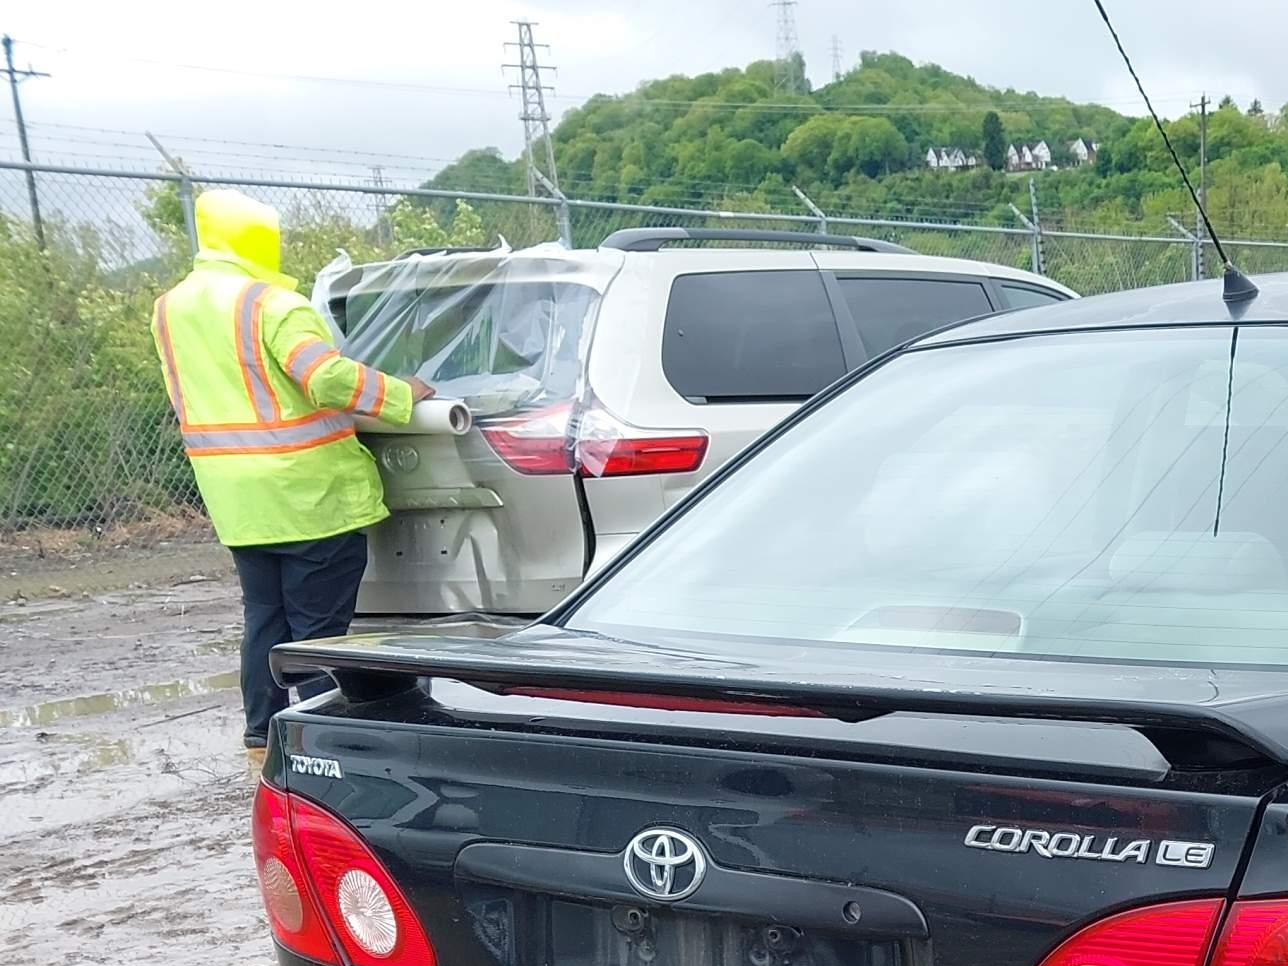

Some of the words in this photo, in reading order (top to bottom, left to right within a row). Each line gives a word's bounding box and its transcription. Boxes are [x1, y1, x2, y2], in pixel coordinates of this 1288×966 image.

[290, 755, 342, 778] TOYOTA
[964, 825, 1150, 864] COROLLA
[1158, 842, 1212, 866] LE
